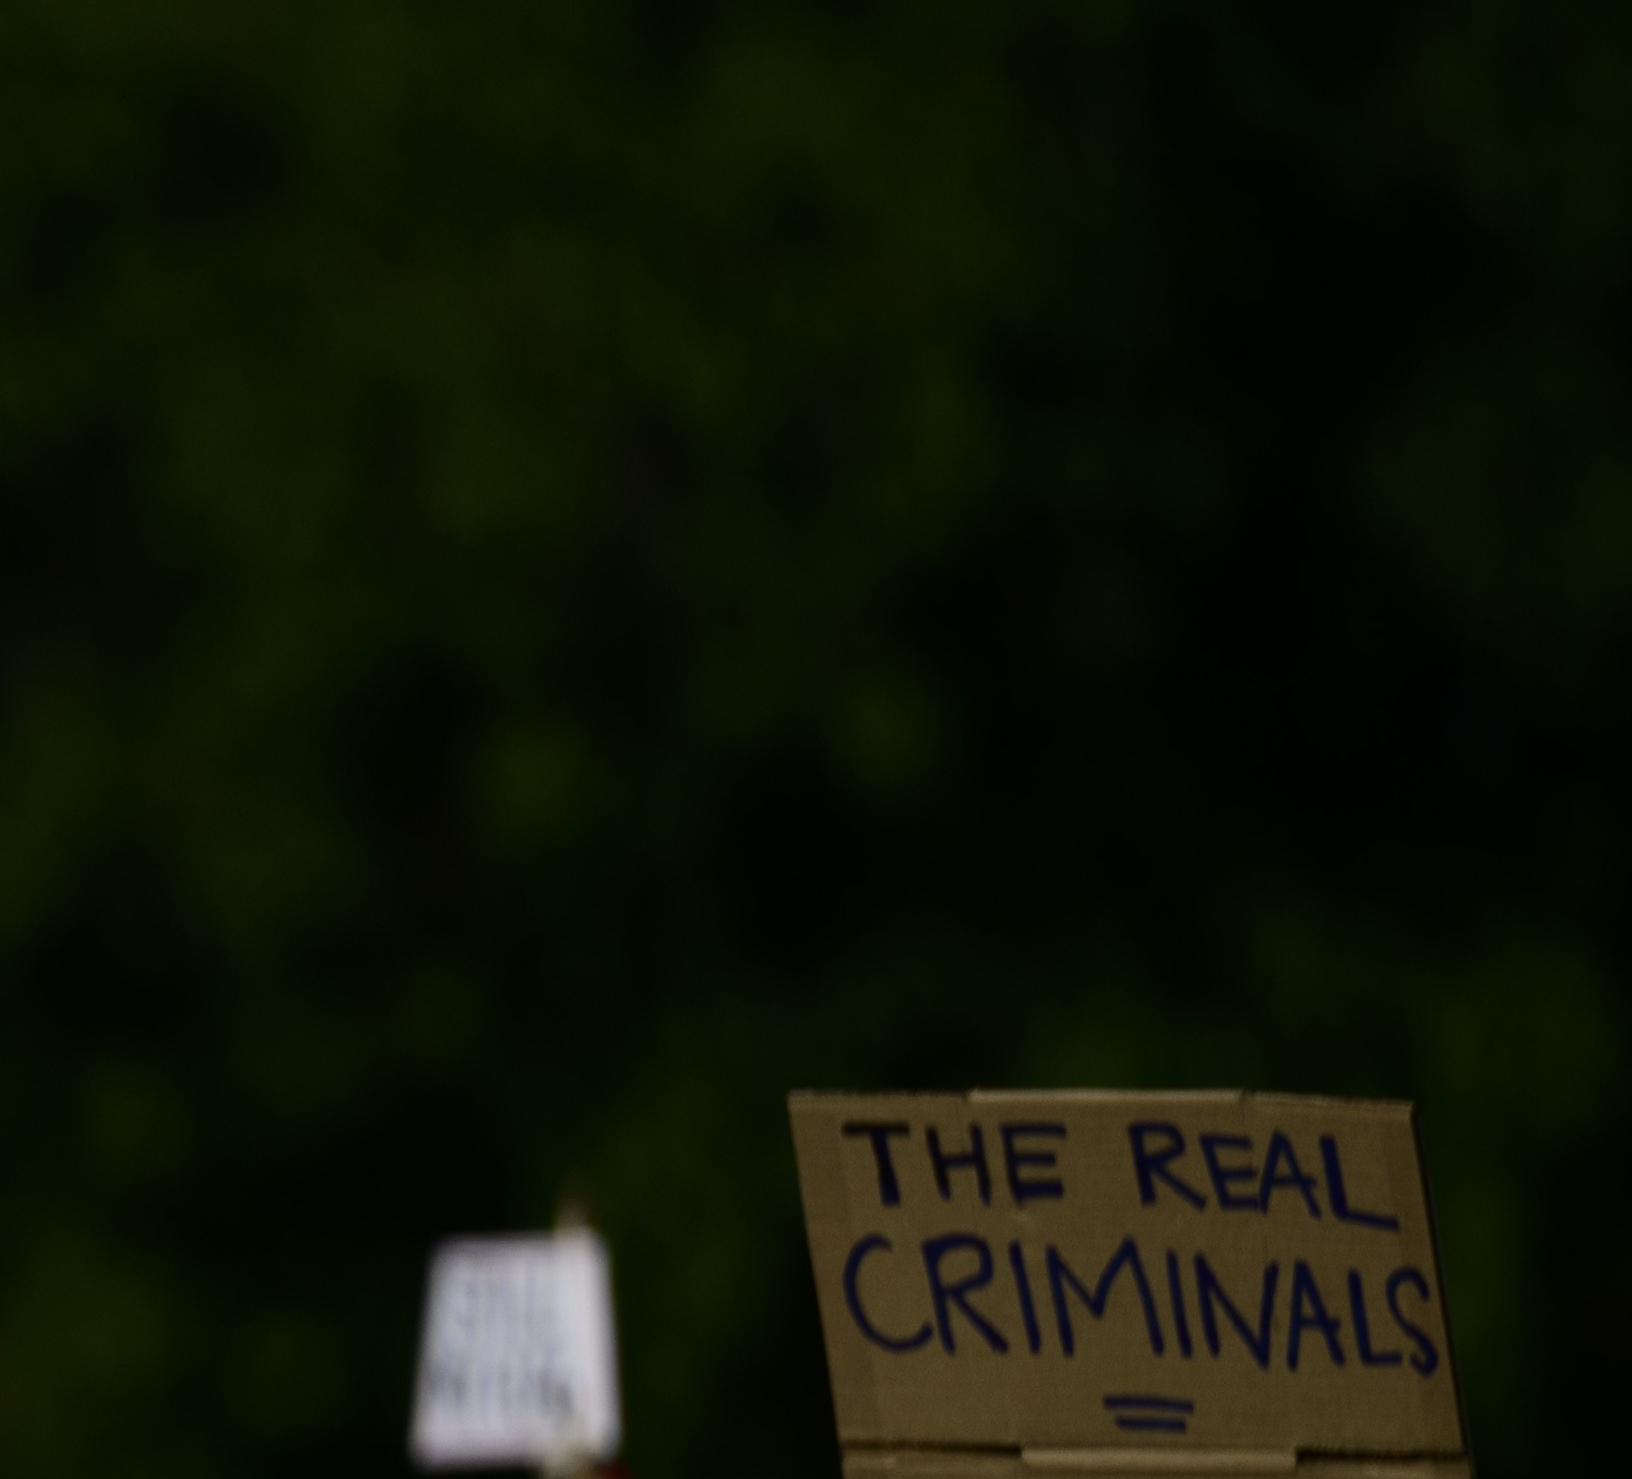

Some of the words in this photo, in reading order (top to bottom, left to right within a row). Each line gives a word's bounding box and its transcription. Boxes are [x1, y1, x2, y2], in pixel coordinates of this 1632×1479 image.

[842, 1121, 1068, 1206] THE
[1127, 1121, 1401, 1232] REAL
[843, 1235, 1439, 1377] CRIMINALS
